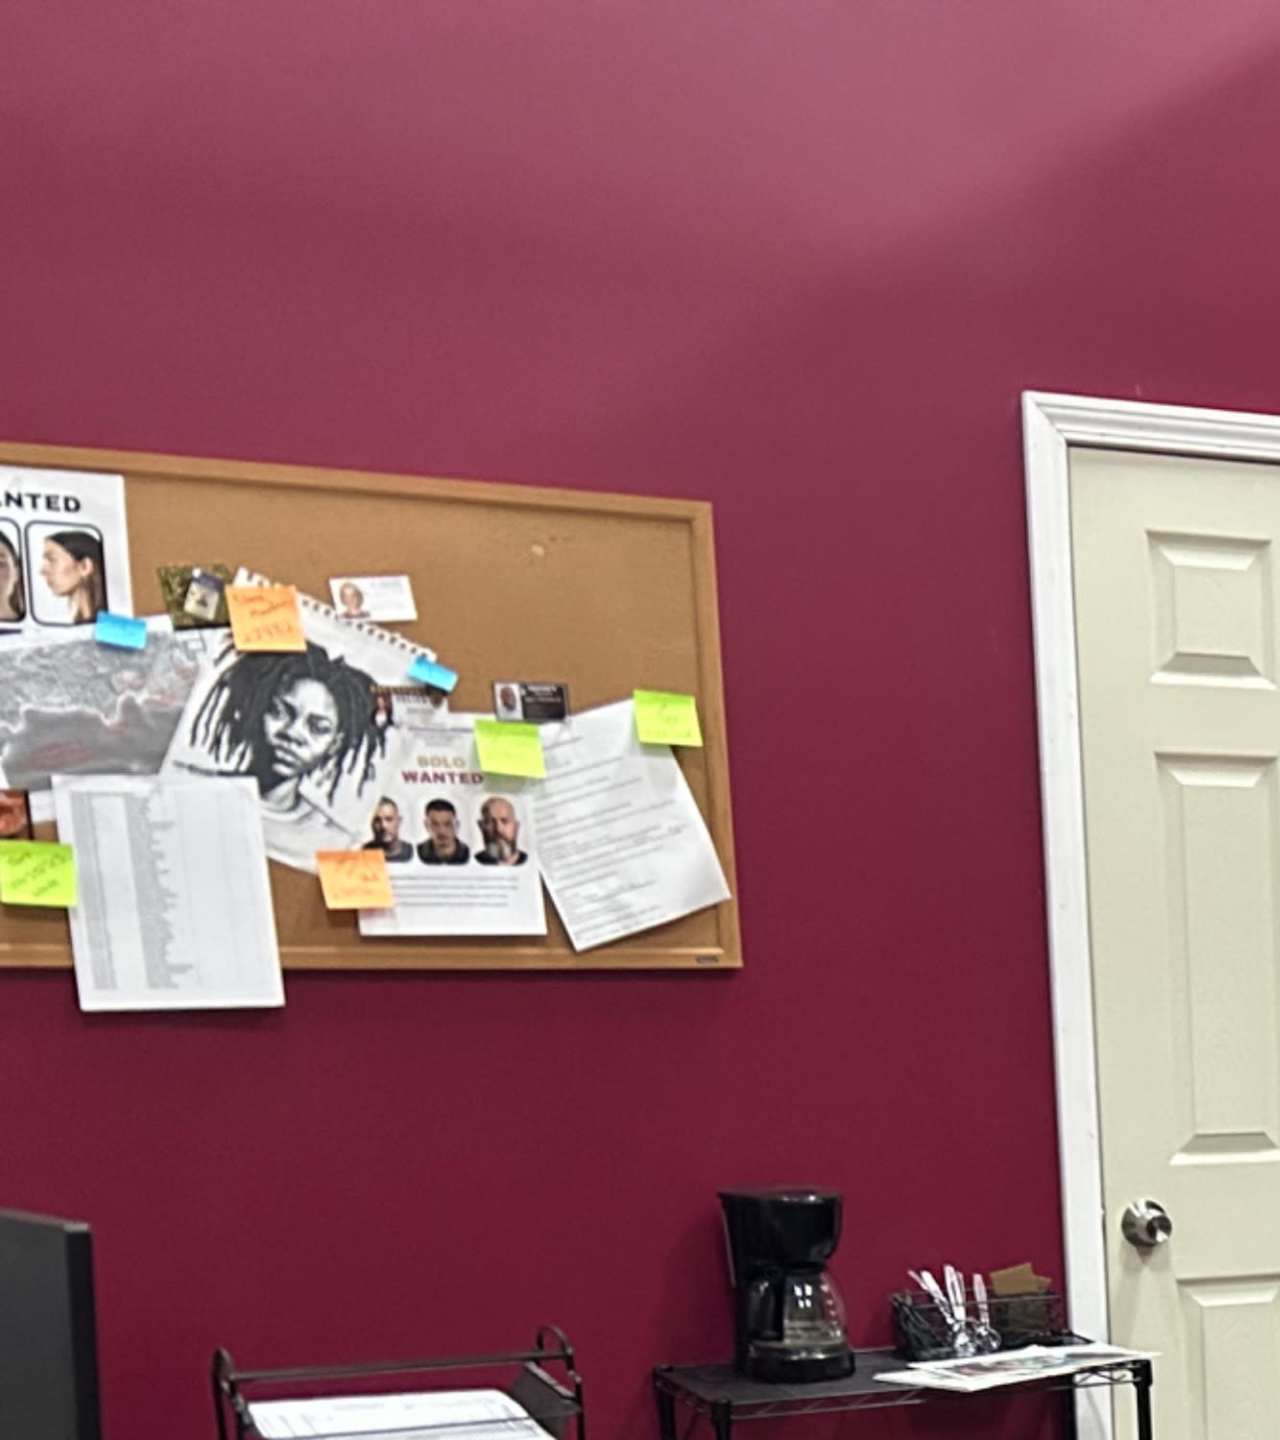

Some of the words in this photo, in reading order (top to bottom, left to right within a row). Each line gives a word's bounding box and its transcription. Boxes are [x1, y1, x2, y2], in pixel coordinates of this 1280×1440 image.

[0, 490, 81, 512] NTED
[417, 755, 465, 768] BOLO
[402, 770, 484, 785] WANTED
